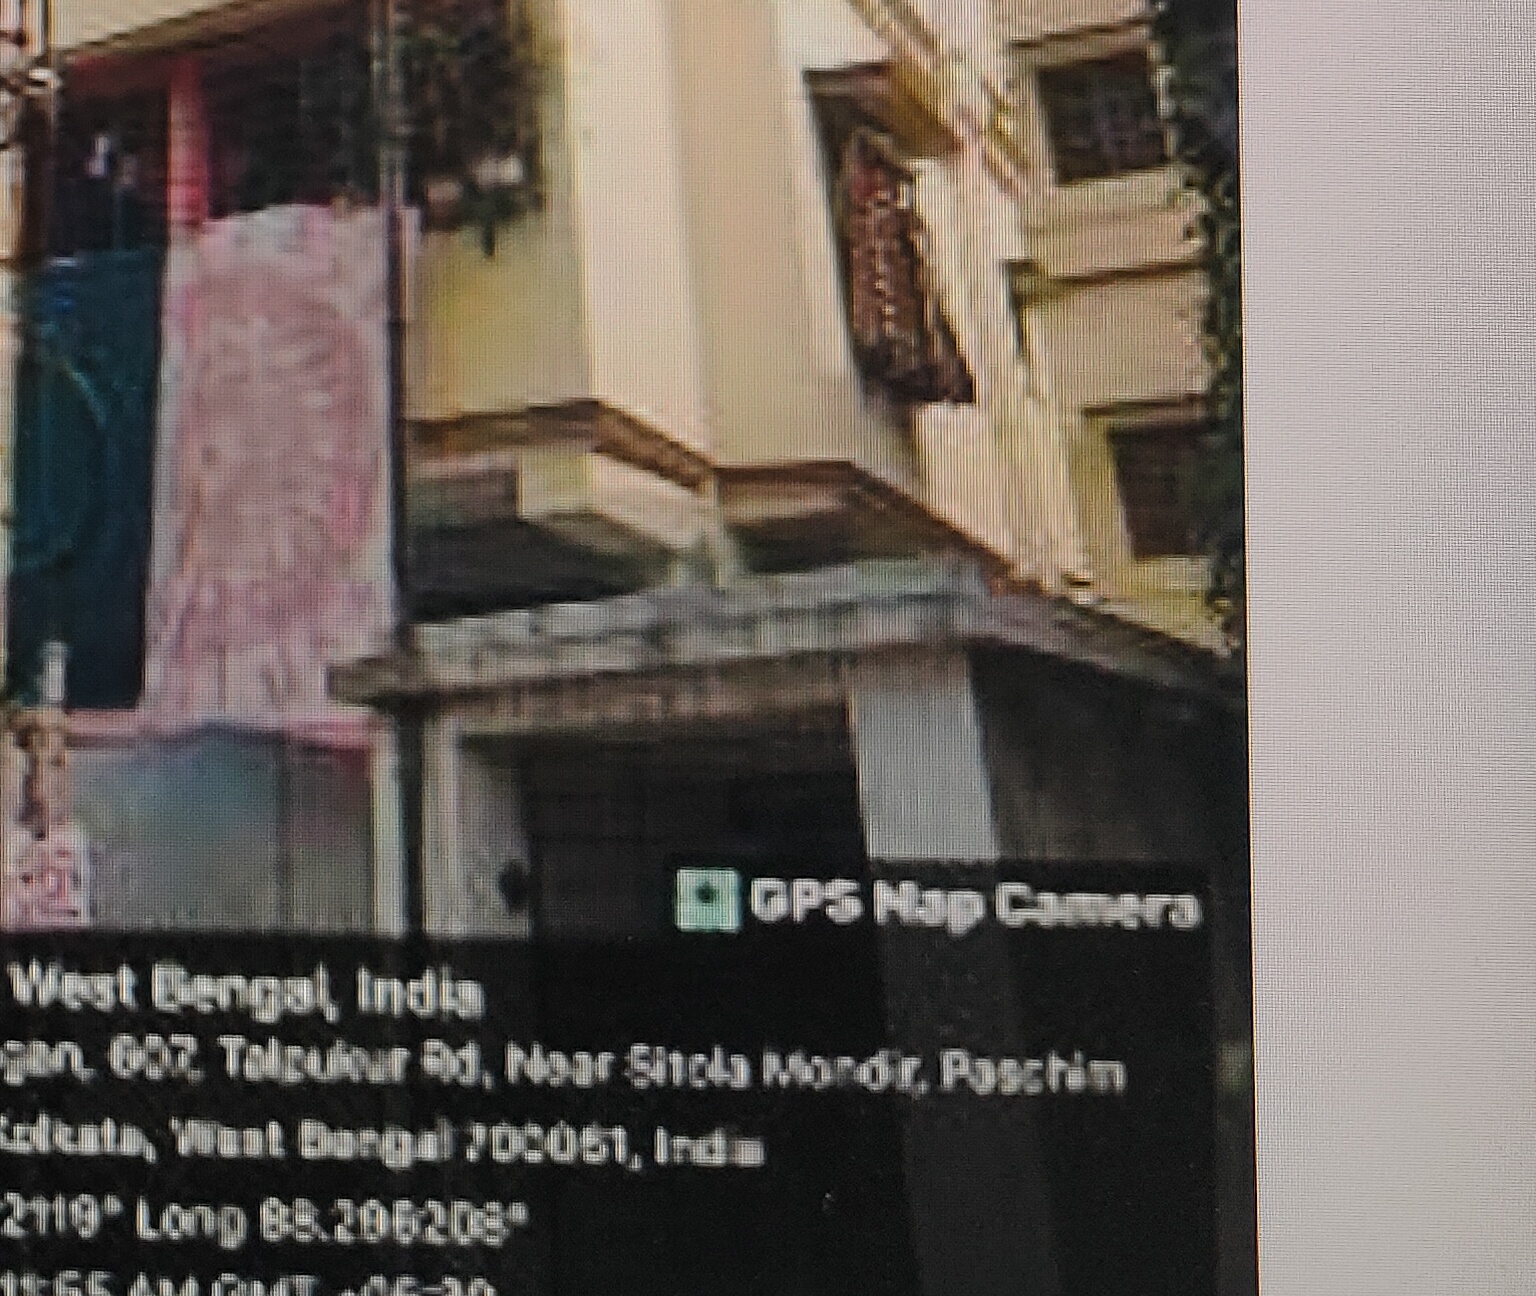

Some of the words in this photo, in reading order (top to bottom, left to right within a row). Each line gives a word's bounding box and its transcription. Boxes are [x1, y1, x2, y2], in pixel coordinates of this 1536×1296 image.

[750, 877, 864, 924] GPS
[873, 880, 987, 937] Map
[994, 882, 1202, 930] Camera
[6, 958, 137, 1011] West
[151, 958, 340, 1024] Bengal,
[357, 963, 486, 1020] India
[505, 1039, 616, 1089] Near
[939, 1047, 1127, 1096] Paschim
[168, 1115, 286, 1160] West
[298, 1115, 455, 1172] Bengal
[654, 1125, 766, 1168] India
[135, 1196, 248, 1250] Long
